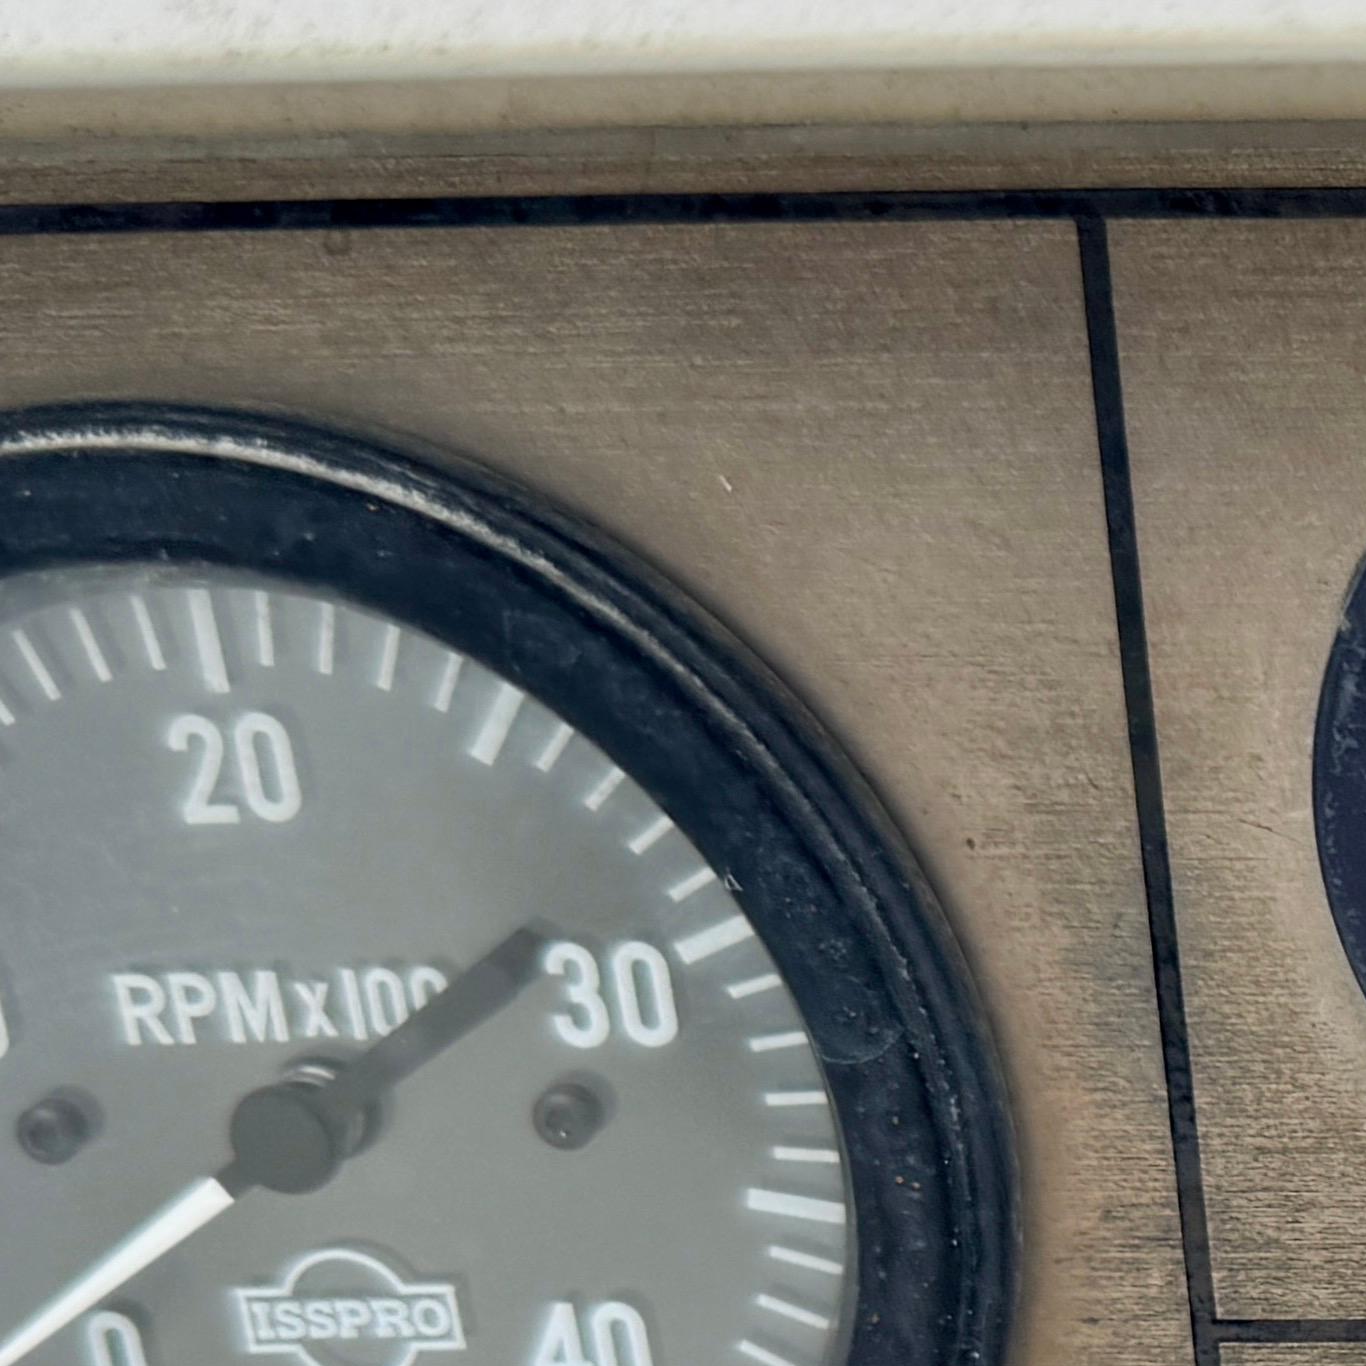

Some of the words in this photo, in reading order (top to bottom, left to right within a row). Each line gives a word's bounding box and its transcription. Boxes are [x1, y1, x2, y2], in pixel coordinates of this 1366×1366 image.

[165, 710, 302, 825] 20
[541, 940, 679, 1049] 30
[250, 1298, 451, 1340] ISSPRO
